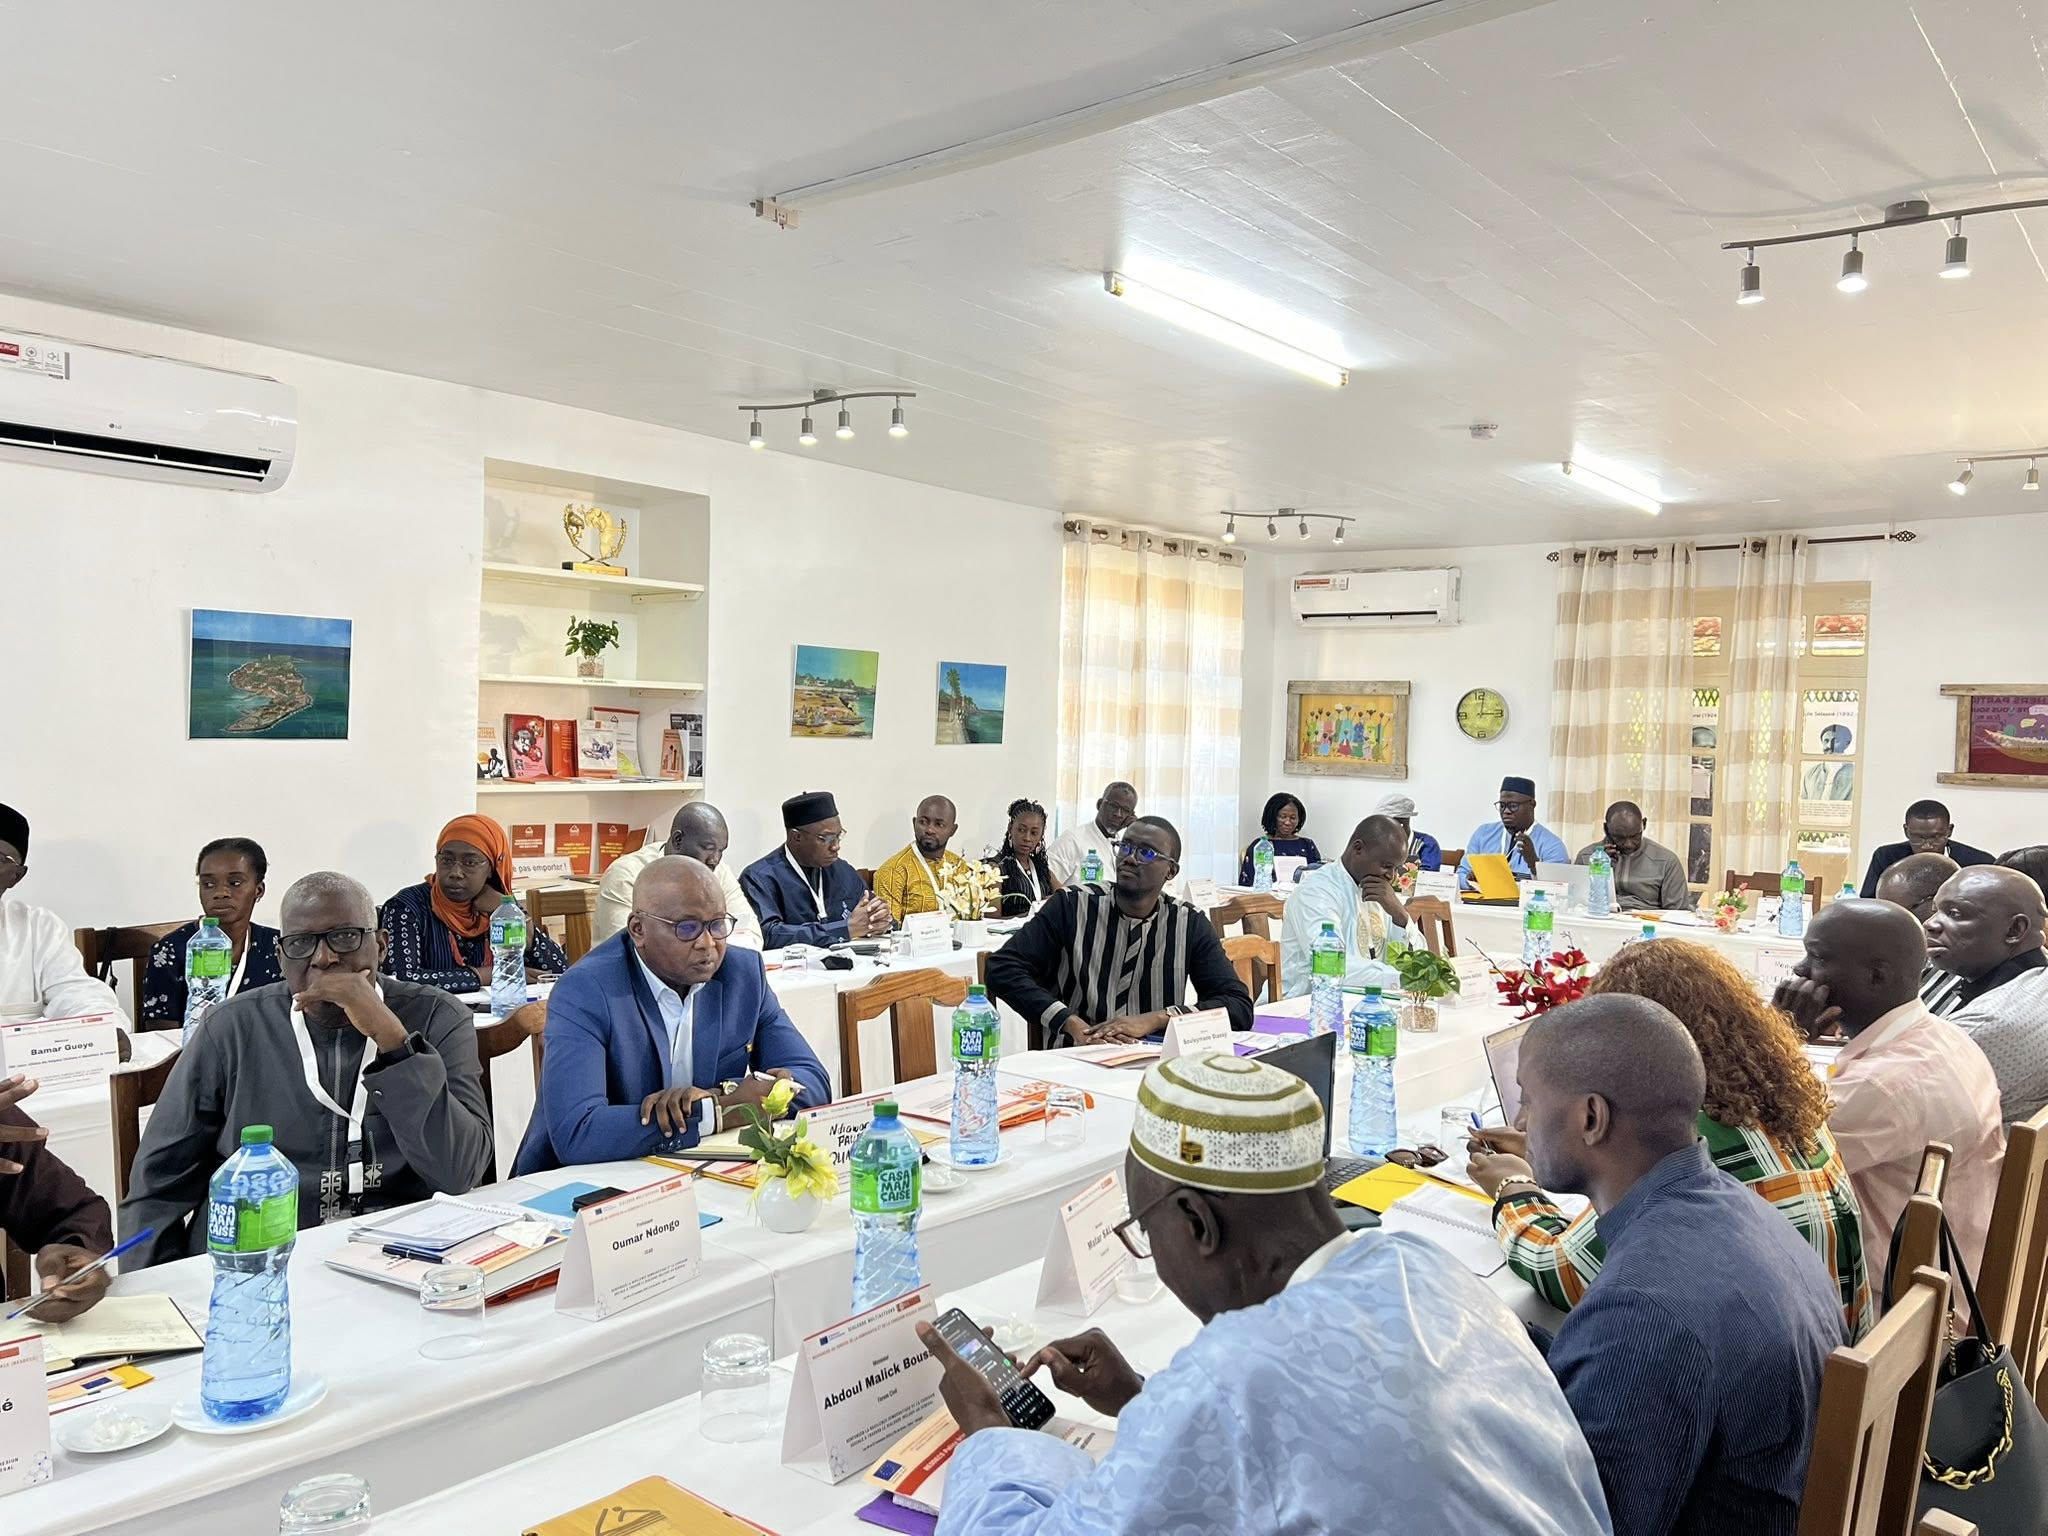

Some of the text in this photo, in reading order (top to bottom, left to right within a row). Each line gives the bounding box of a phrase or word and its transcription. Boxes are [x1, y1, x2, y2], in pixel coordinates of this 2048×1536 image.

[1475, 692, 1485, 700] 12
[1494, 709, 1504, 718] 3
[1478, 730, 1486, 738] 6
[532, 863, 563, 872] emporter
[962, 1030, 982, 1040] CASA
[31, 1046, 62, 1056] Bamar
[880, 1170, 910, 1181] CASA
[882, 1180, 910, 1192] MAN
[210, 1202, 236, 1216] CASA
[612, 1219, 680, 1251] Oumar Ndongo
[824, 1380, 862, 1410] Abdoul
[865, 1363, 901, 1389] Malick
